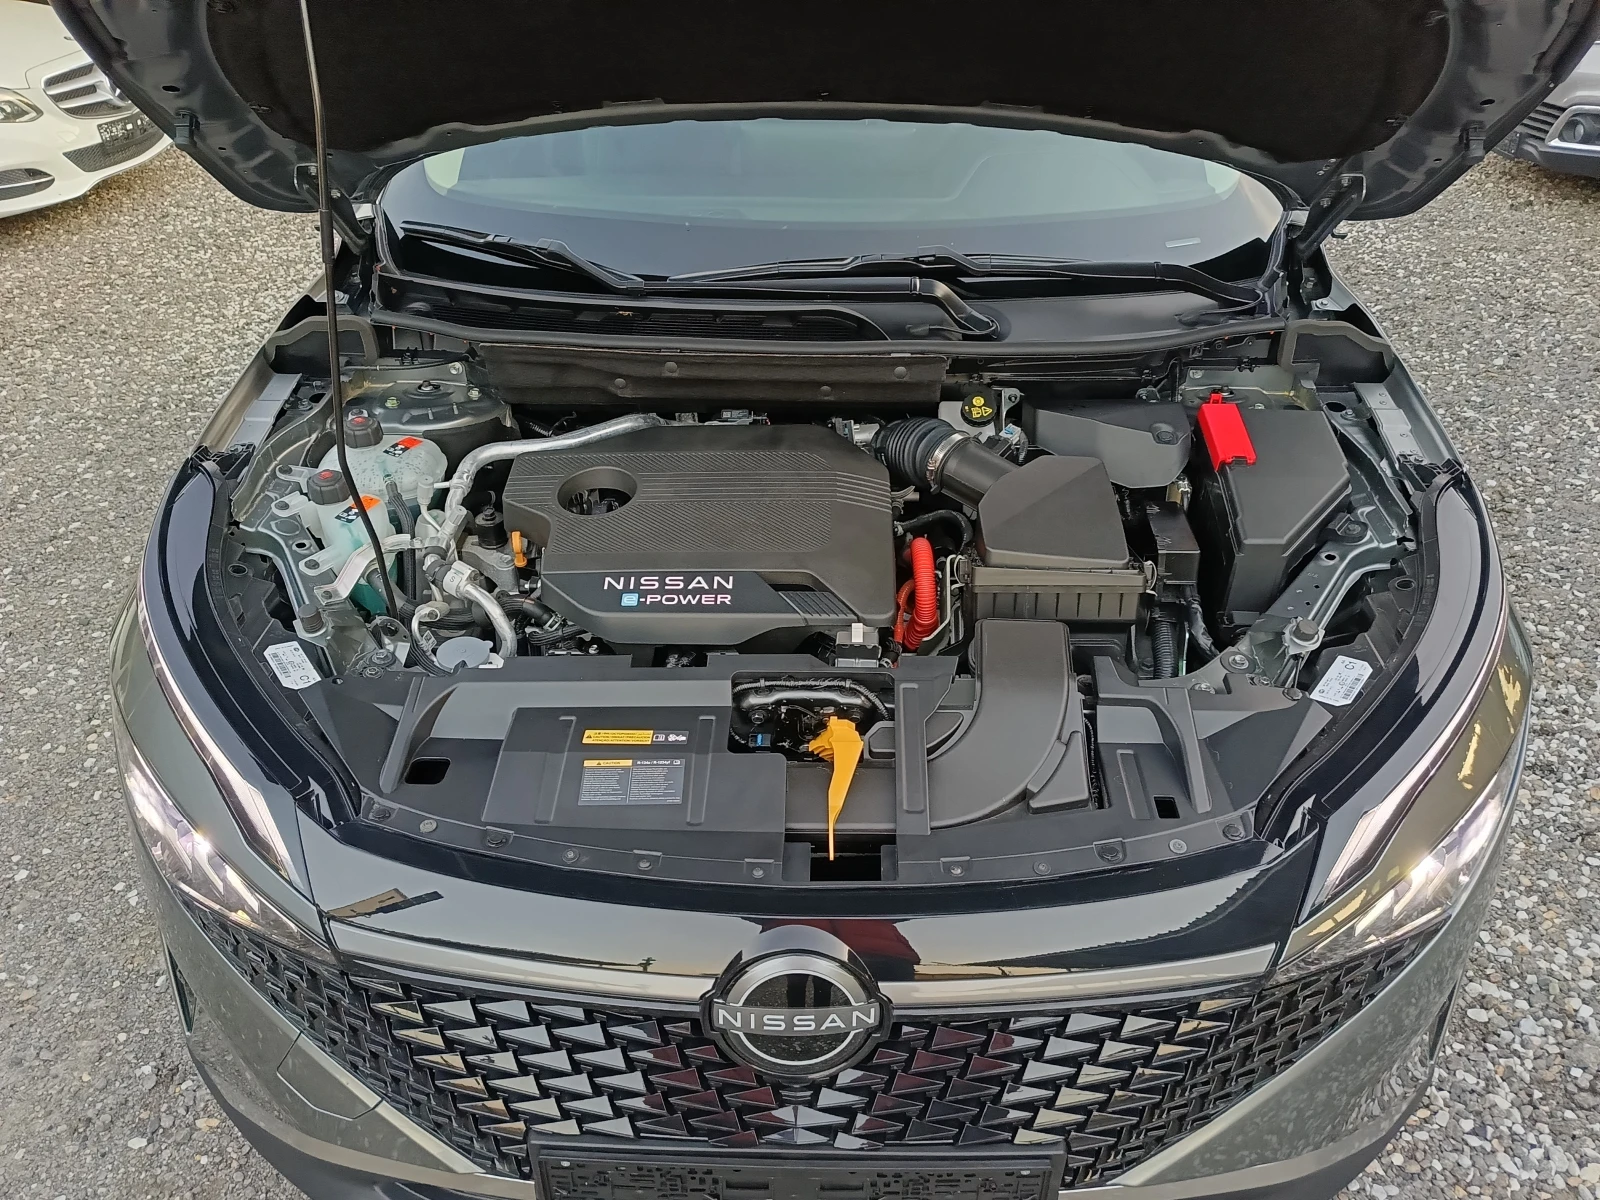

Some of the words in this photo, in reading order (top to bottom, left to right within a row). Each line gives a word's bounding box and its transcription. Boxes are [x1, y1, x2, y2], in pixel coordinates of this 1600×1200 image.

[603, 576, 734, 590] NISSAN
[621, 593, 732, 607] e-POWER
[299, 675, 312, 684] C1
[718, 1007, 876, 1031] NISSAN
